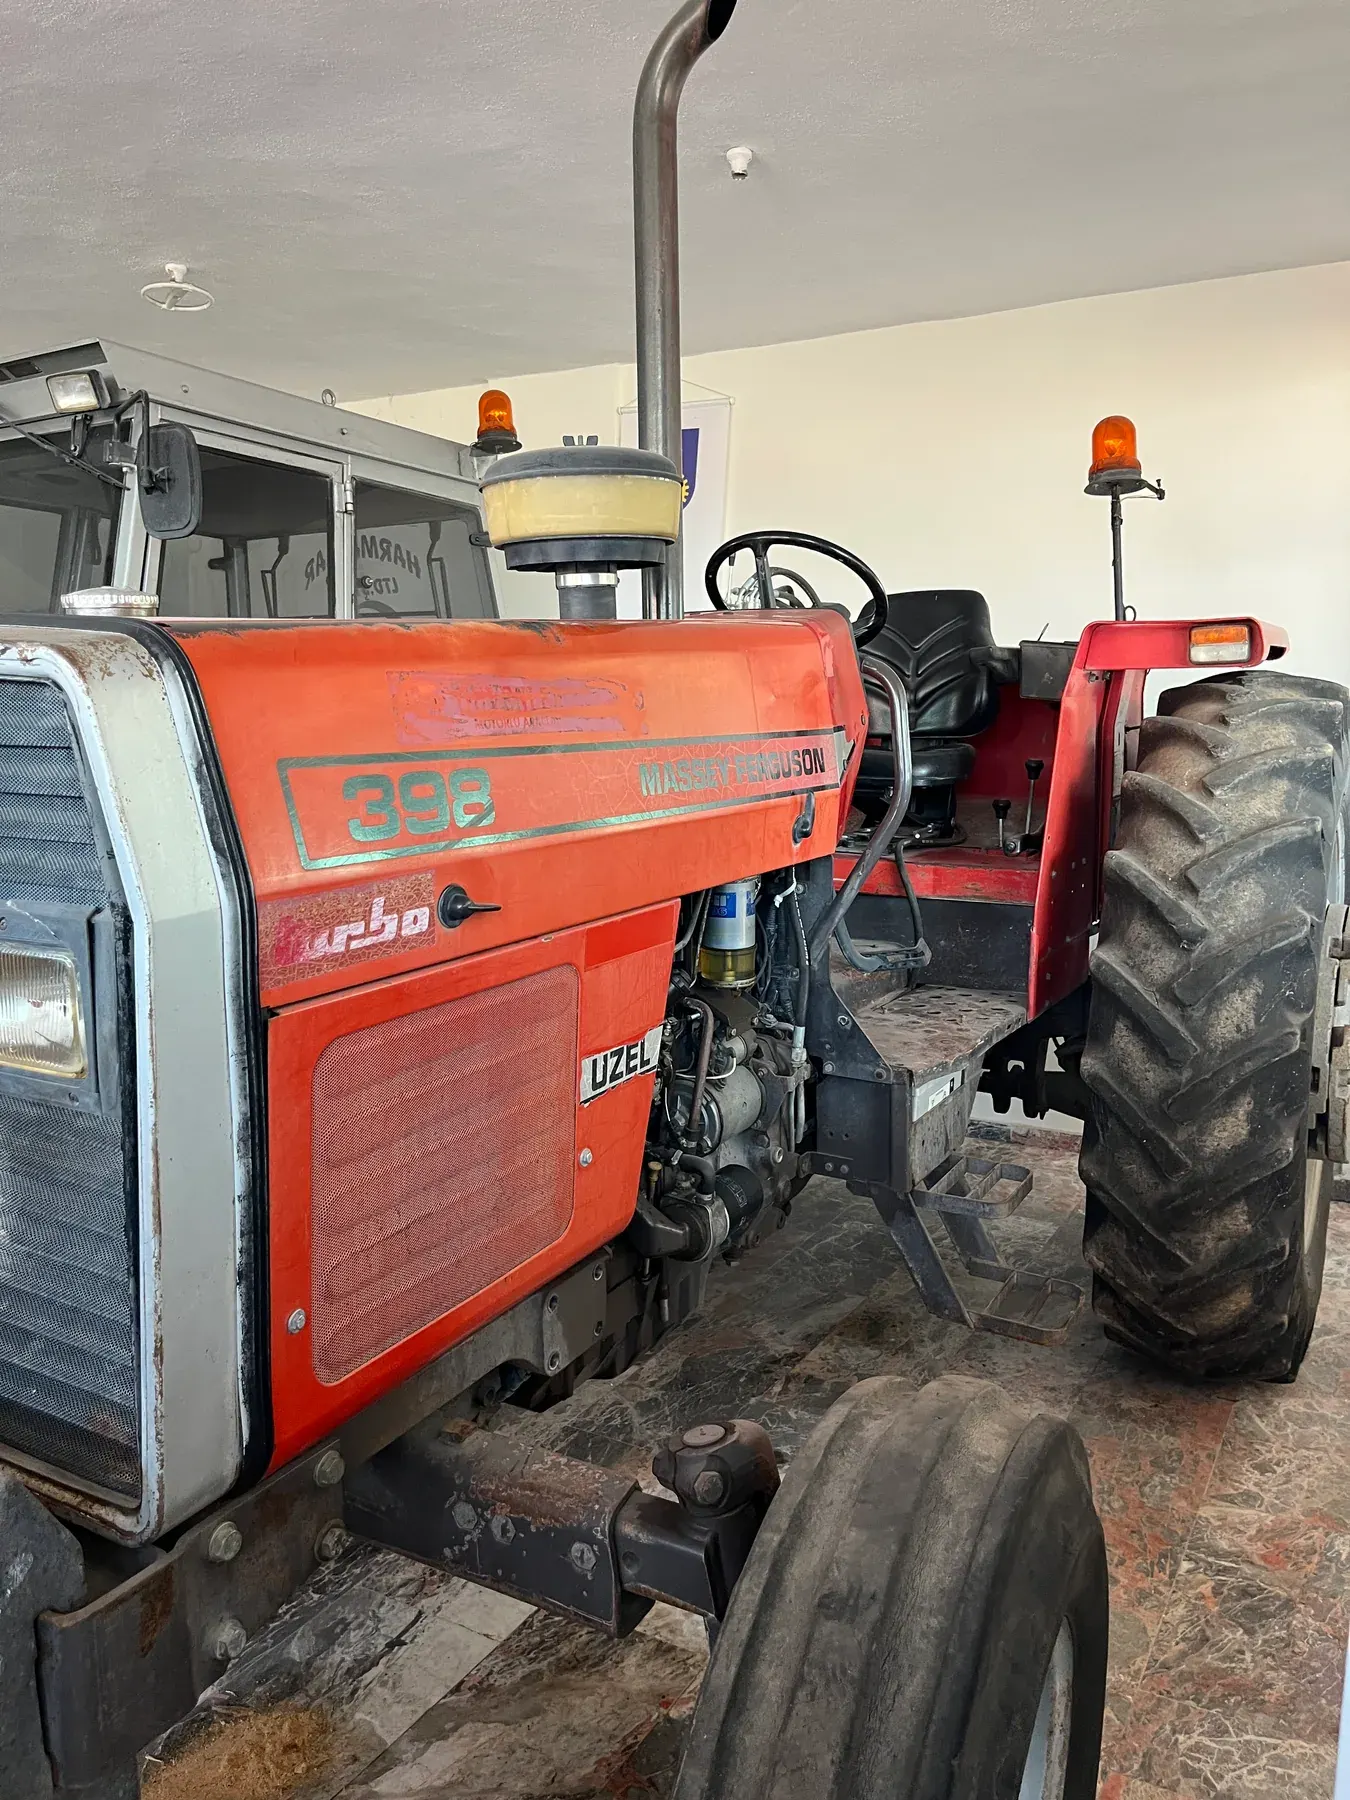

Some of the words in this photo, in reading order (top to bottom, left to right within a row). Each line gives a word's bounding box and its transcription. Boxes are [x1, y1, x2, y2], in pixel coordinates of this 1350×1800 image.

[638, 756, 729, 797] MASSEY
[734, 747, 826, 785] FERGUSON
[343, 767, 495, 842] 398
[591, 1037, 651, 1092] UZEL
